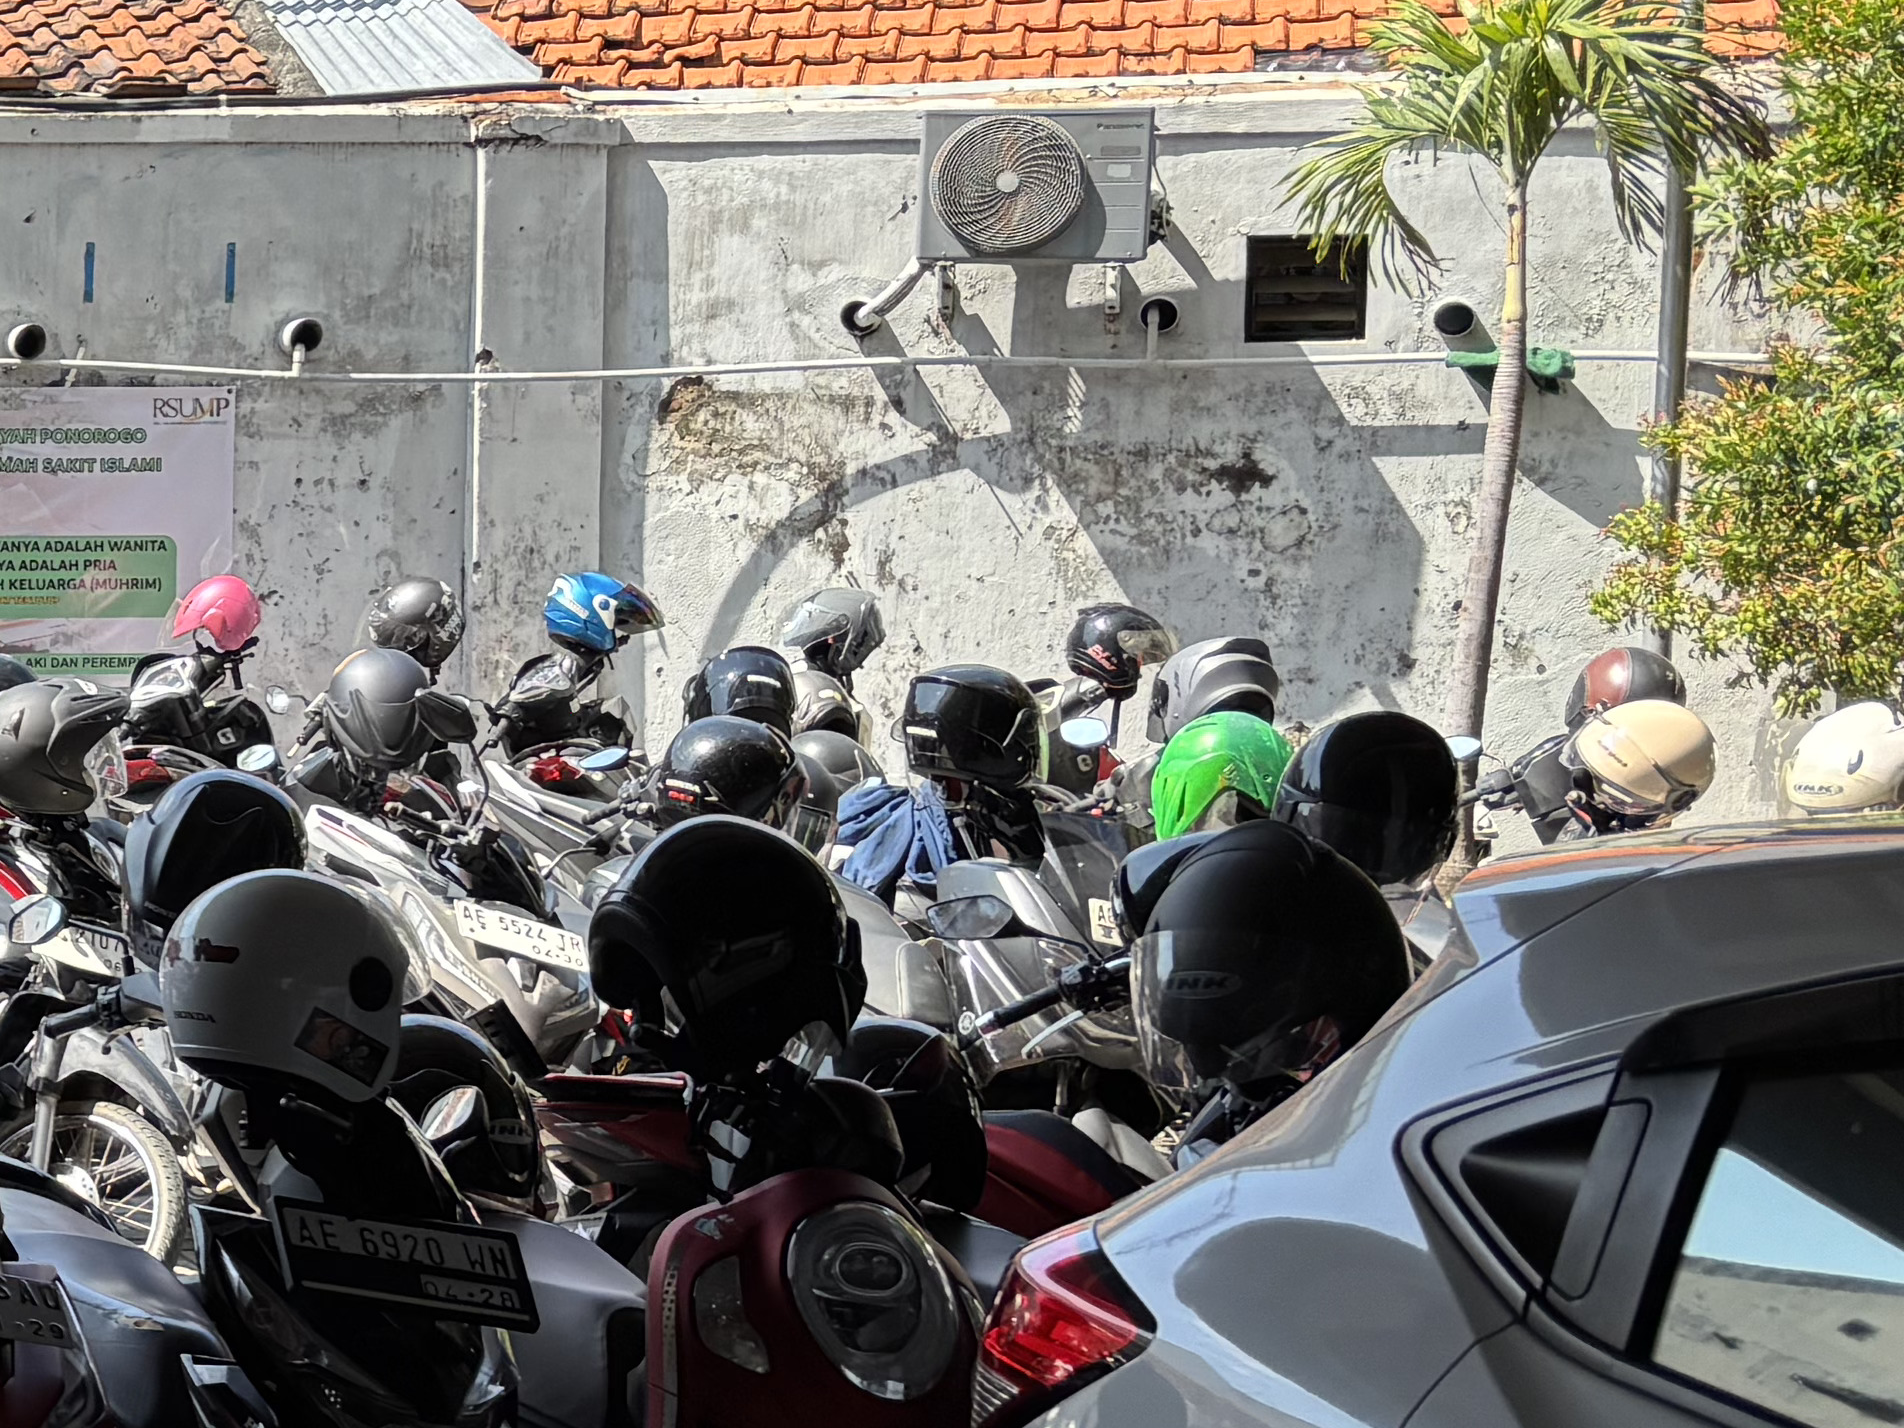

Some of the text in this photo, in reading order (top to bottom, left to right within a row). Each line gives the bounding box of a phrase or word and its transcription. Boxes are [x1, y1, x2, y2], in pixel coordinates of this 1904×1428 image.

[153, 397, 230, 420] RSUMP
[40, 428, 147, 444] PONOROGO
[42, 458, 96, 473] SAKIT
[100, 457, 162, 472] ISLAMI
[43, 540, 104, 553] ADALAH
[106, 540, 167, 552] WANITA
[18, 559, 79, 572] ADALAH
[83, 559, 117, 572] PRIA
[8, 579, 86, 591] KELUARGA
[90, 577, 162, 592] (MUHRIM)
[50, 657, 74, 668] DAN
[463, 905, 487, 927] AE
[556, 933, 582, 953] JR
[1165, 977, 1229, 991] INK
[299, 1216, 512, 1278] AE 6920 WN
